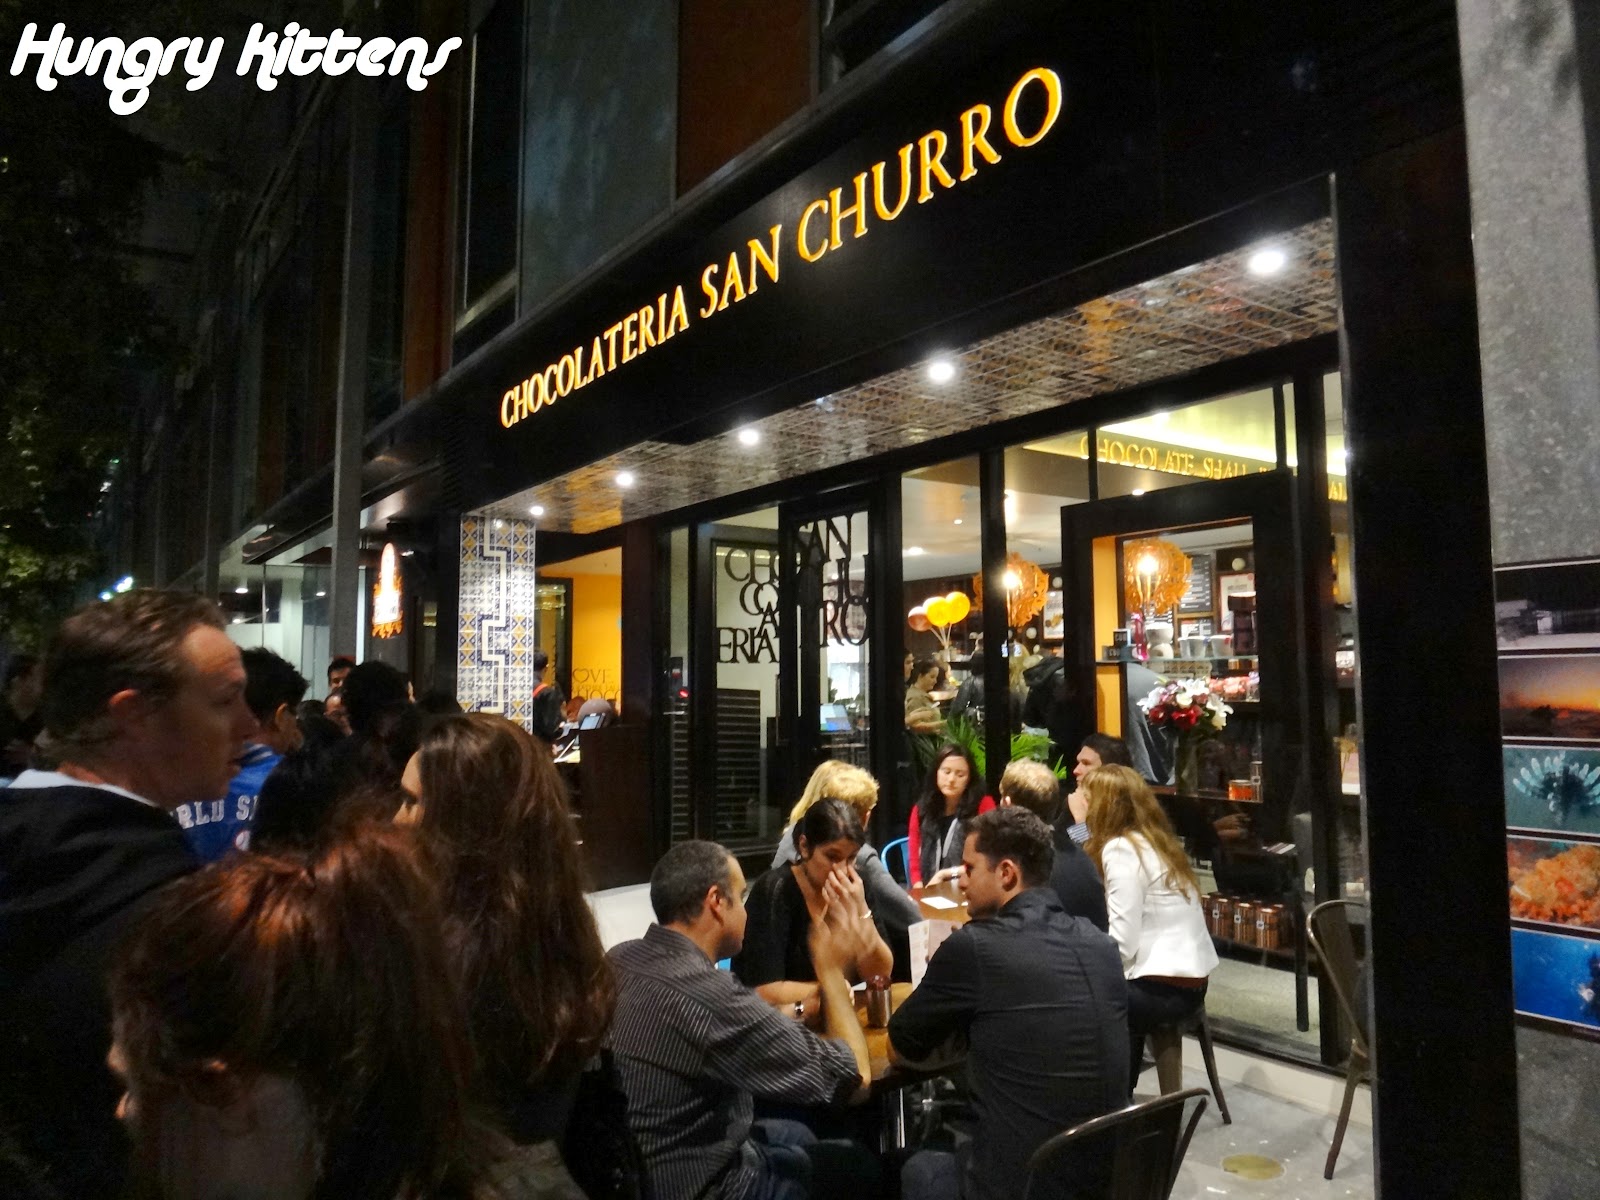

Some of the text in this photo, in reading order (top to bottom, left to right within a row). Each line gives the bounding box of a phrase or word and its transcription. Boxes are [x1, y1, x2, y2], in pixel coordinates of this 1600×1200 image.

[501, 67, 1062, 428] CHOCOLATERIA SAN CHURRO
